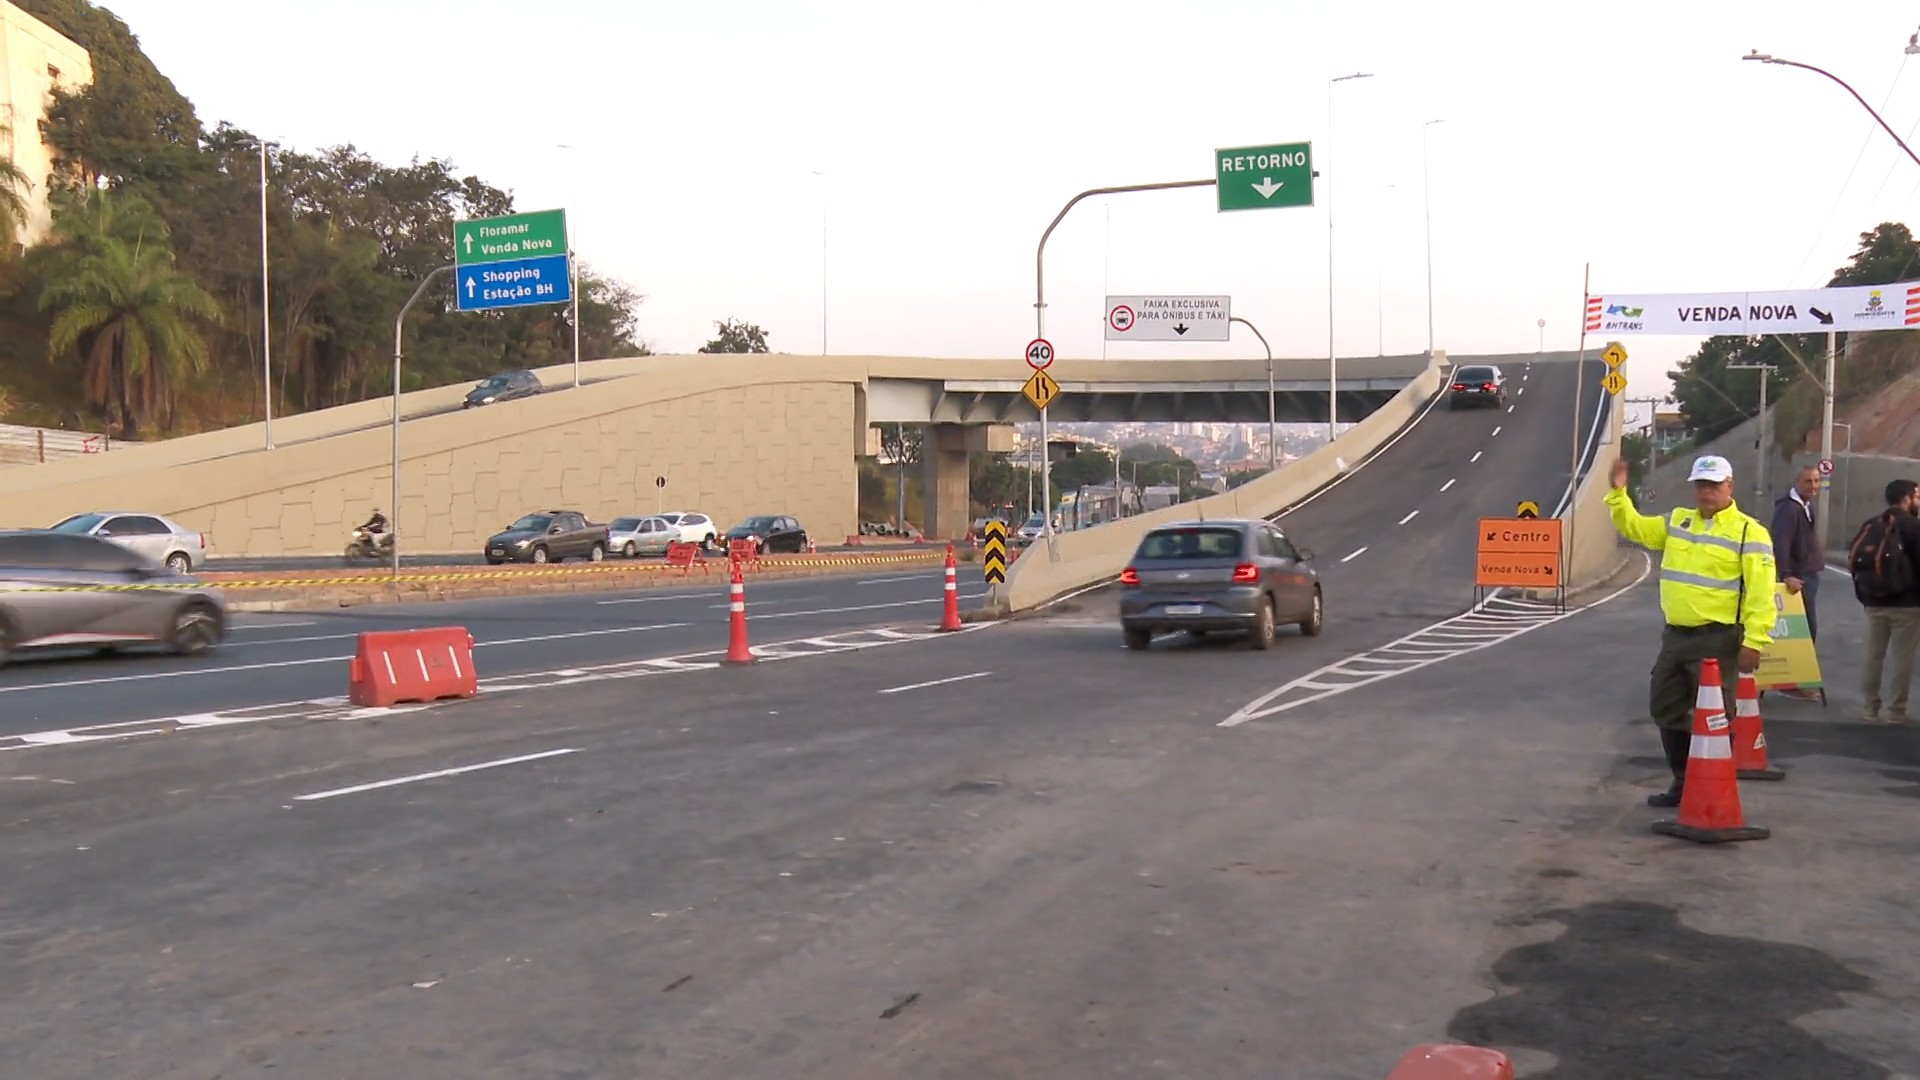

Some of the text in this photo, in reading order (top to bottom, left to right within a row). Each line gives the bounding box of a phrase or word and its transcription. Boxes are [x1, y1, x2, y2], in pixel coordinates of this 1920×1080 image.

[1222, 151, 1306, 172] RETORNO
[480, 223, 530, 238] Floramar
[481, 239, 553, 255] Venda Nova
[483, 267, 541, 283] Shopping
[483, 283, 553, 300] Estação BH
[1143, 299, 1220, 308] FAIXA EXCLUSIVA
[1137, 309, 1225, 320] PARA ÔNIBUS E TÁXI
[1677, 304, 1798, 322] VENDA NOVA
[1605, 321, 1644, 331] BHTRANS
[1029, 346, 1050, 359] 40
[1502, 530, 1550, 542] Centro
[1481, 564, 1540, 574] Venda Nova
